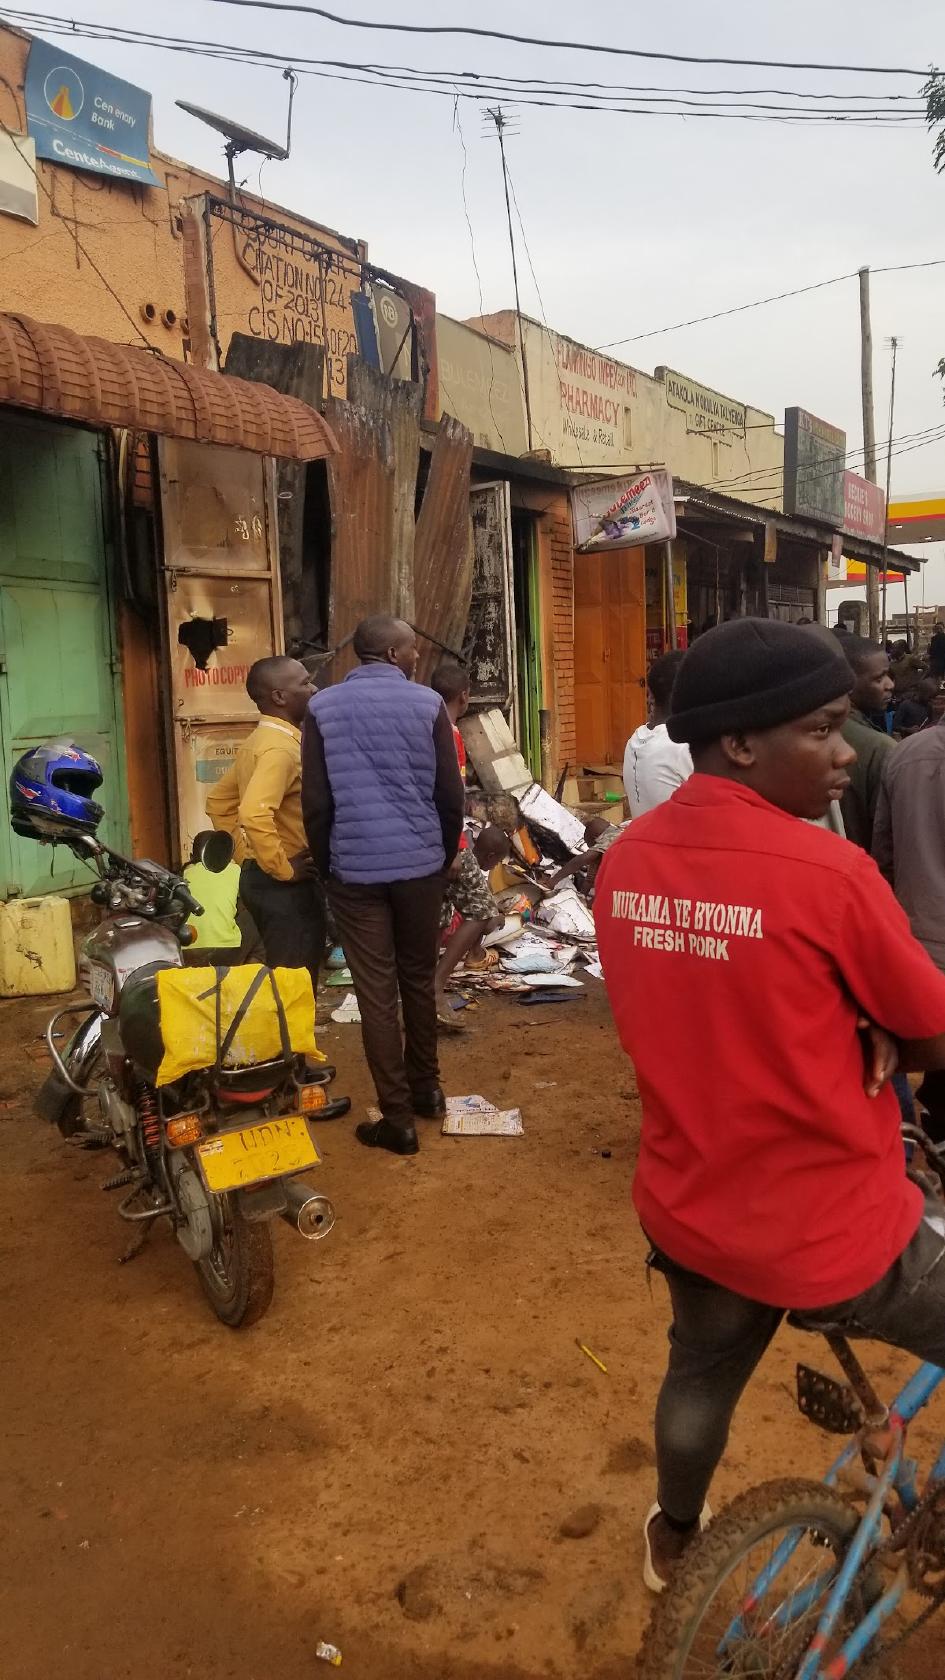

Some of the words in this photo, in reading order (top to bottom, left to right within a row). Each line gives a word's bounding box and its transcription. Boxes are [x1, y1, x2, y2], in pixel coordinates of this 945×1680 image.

[91, 112, 114, 130] Bank
[94, 97, 136, 128] Cenenary
[262, 280, 284, 304] OF
[284, 290, 320, 323] 2013
[560, 380, 619, 428] PHARMACY
[611, 890, 671, 926] MUKAMA
[673, 898, 692, 929] YE
[694, 901, 764, 939] BYONNA
[633, 926, 686, 953] FRESH
[688, 933, 730, 961] PORK
